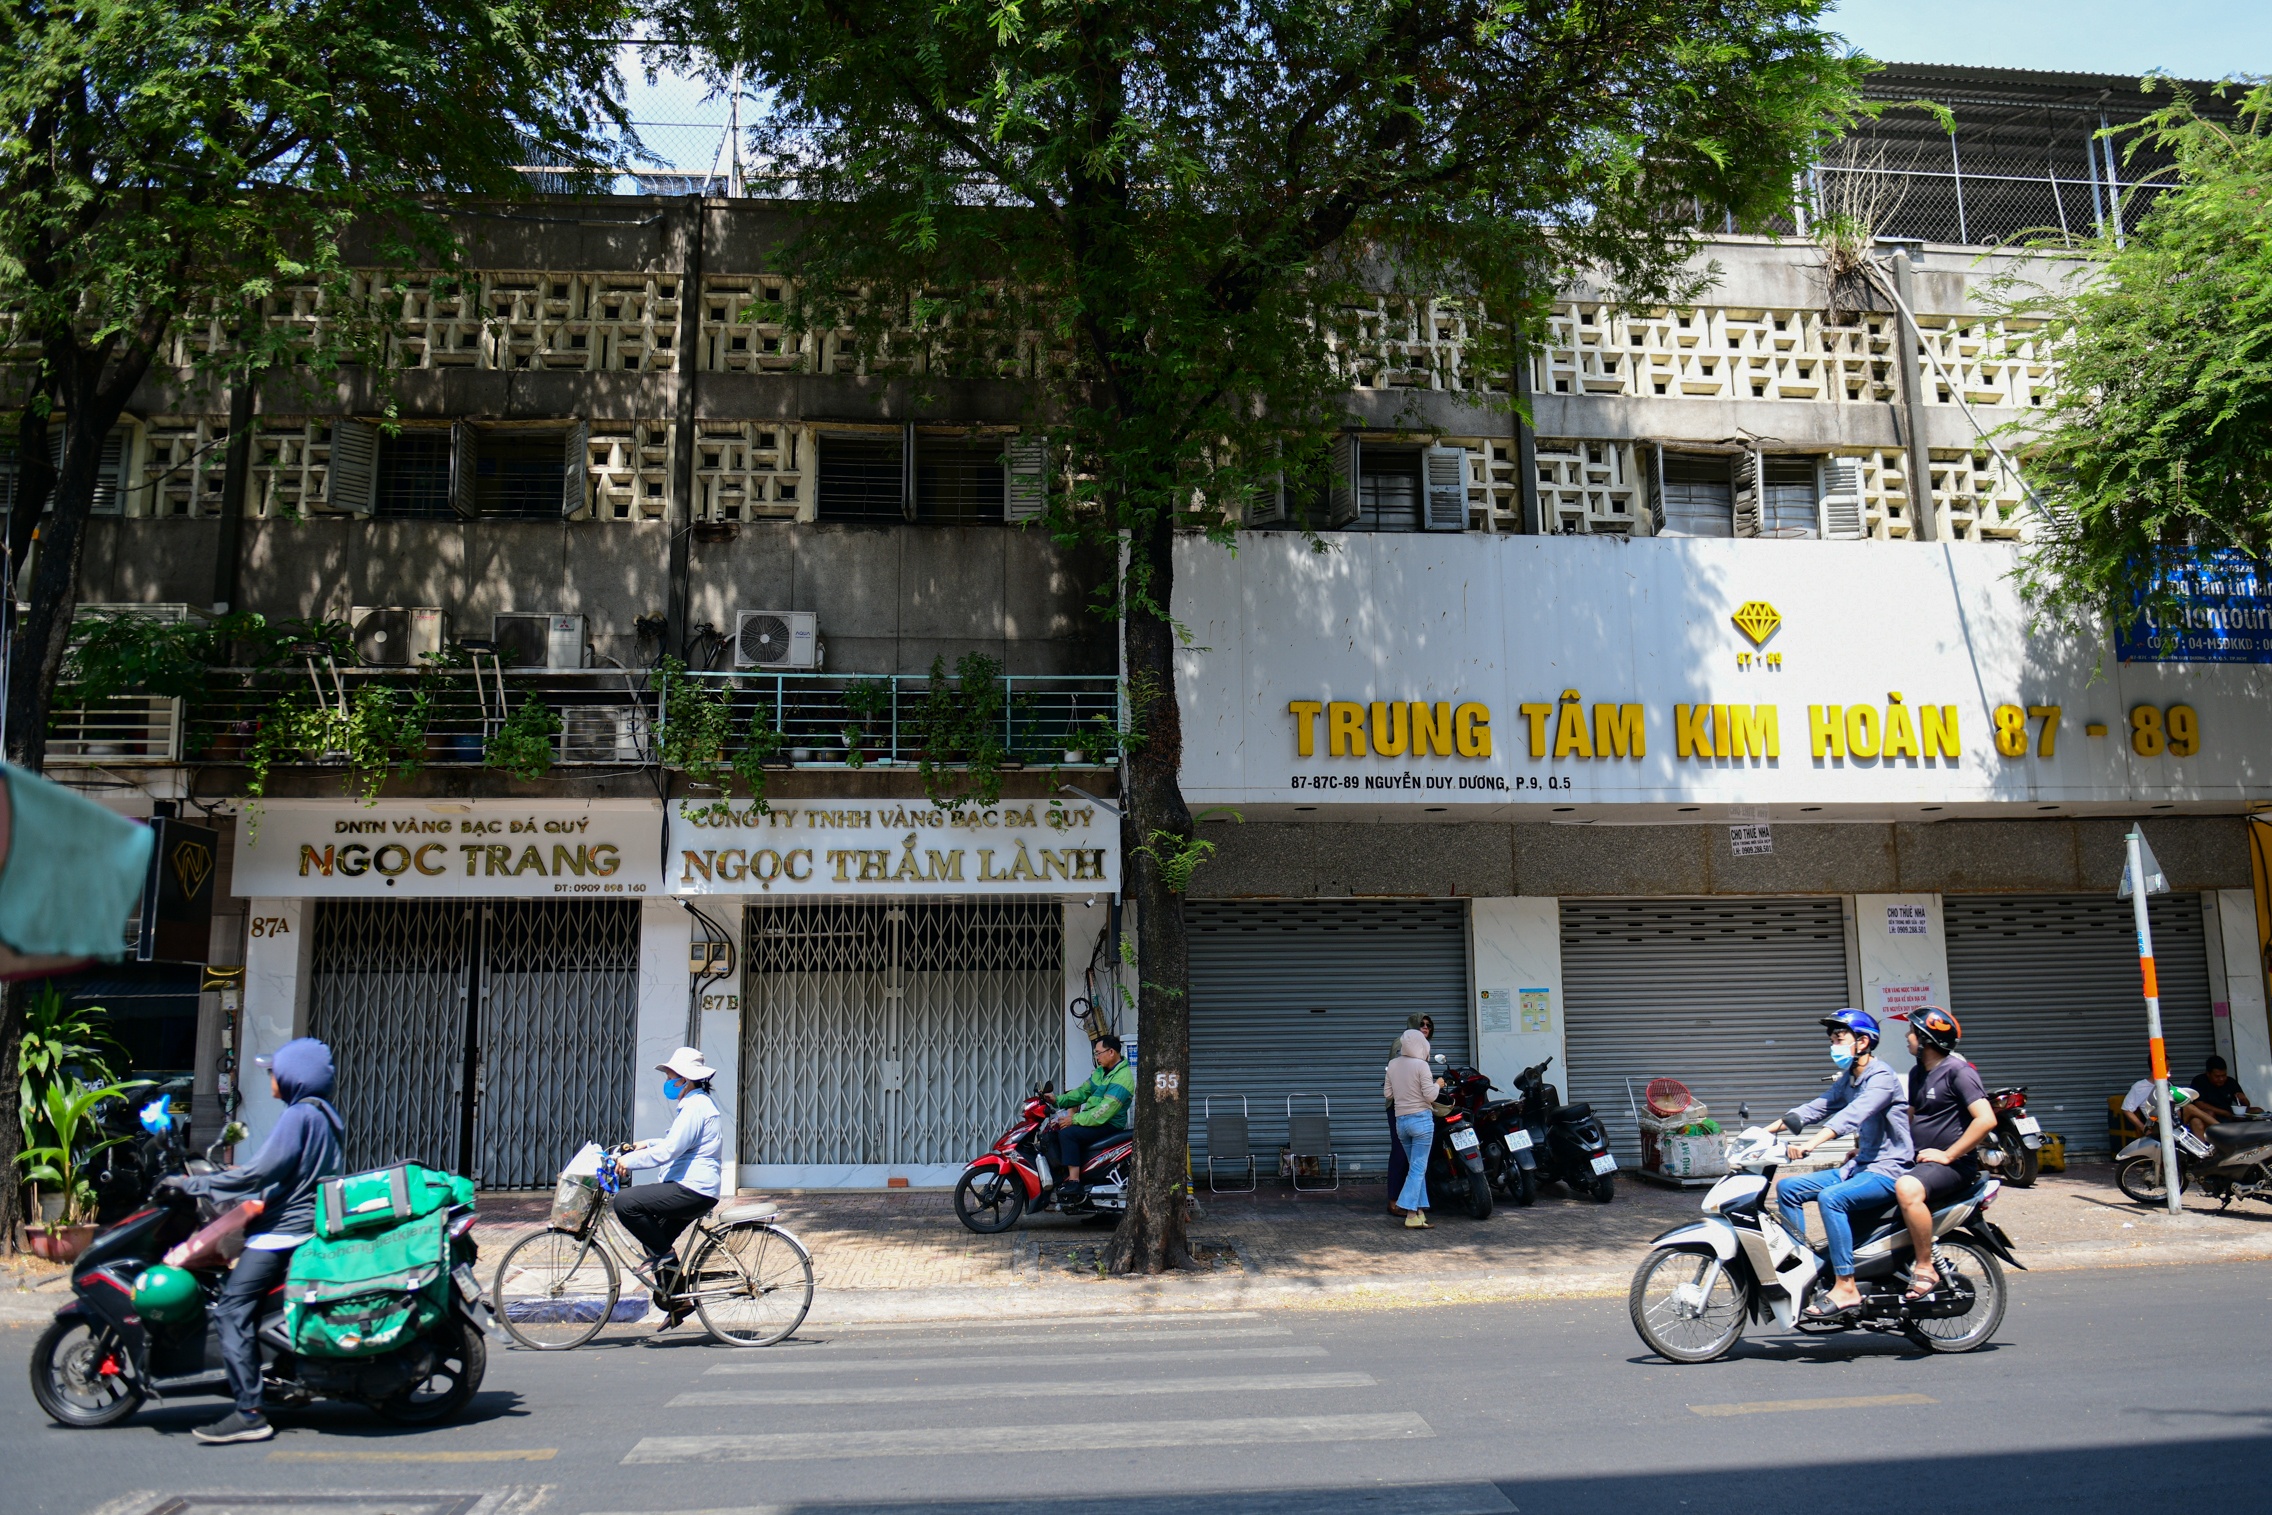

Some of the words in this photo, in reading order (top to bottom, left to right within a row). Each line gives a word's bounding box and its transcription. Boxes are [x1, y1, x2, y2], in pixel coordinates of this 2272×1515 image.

[1737, 652, 1752, 665] 87
[1766, 652, 1782, 665] 89
[1289, 700, 1491, 757] TRUNG
[1520, 689, 1646, 757] TÂM
[1674, 704, 1780, 757] KIM
[1807, 691, 1961, 757] HOÀN
[1993, 704, 2062, 757] 87
[2085, 724, 2108, 737] -
[2129, 704, 2200, 758] 89
[1291, 776, 1360, 789] 87-87C-89
[1365, 771, 1421, 789] NGUYỄN
[1426, 776, 1453, 789] DUY
[1459, 775, 1509, 792] DƯƠNG,
[1516, 777, 1542, 791] P.9,
[1548, 777, 1571, 790] Q.5
[334, 820, 386, 833] DNTN
[392, 816, 453, 833] VÀNG
[460, 820, 502, 838] BẠC
[509, 816, 538, 833] ĐÁ
[544, 816, 590, 833] QUÝ
[767, 809, 798, 828] TY
[804, 810, 871, 828] TNHH
[877, 804, 944, 828] VÀNG
[950, 809, 999, 833] BẠC
[1004, 804, 1038, 828] ĐÁ
[1731, 829, 1743, 840] CHO
[299, 843, 448, 886] NGỌC
[459, 844, 621, 876] TRANG
[681, 849, 813, 890] NGỌC
[826, 832, 965, 882] THẮM
[977, 838, 1106, 882] LÀNH
[574, 884, 600, 892] 0909
[603, 884, 624, 892] 898
[627, 884, 647, 892] 160
[1887, 908, 1898, 917] CHO
[1899, 905, 1913, 917] THUÊ
[1914, 905, 1926, 917] NHÀ
[251, 917, 290, 938] 87A
[703, 995, 739, 1010] 87B
[1156, 1073, 1179, 1089] 55
[1680, 1157, 1690, 1175] PHÚ
